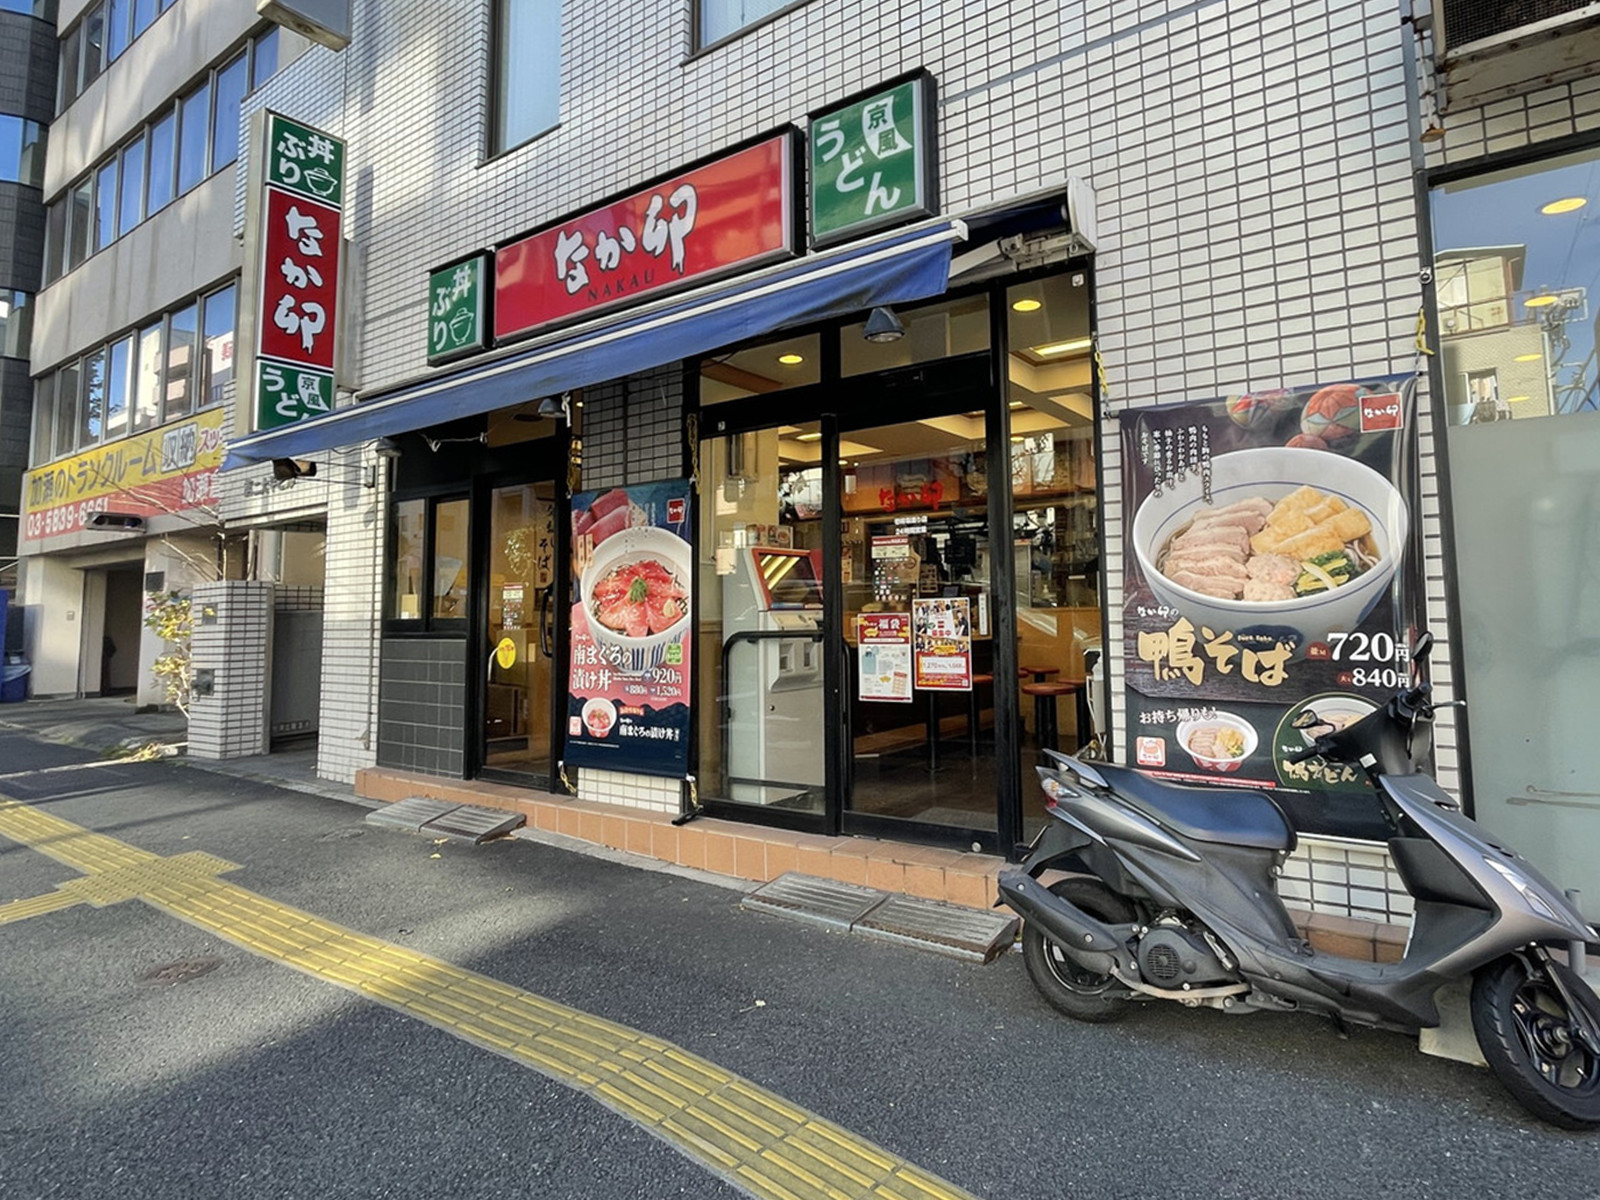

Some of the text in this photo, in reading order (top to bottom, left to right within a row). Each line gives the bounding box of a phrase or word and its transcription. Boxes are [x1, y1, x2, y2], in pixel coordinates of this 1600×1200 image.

[867, 103, 899, 156] 京風
[816, 119, 901, 215] うどん
[554, 183, 697, 295] なか卯
[273, 205, 325, 354] なか卯
[588, 269, 656, 302] NAKAU
[262, 367, 310, 421] うど
[301, 376, 321, 407] 京風
[1364, 404, 1399, 418] なか卯
[1137, 606, 1179, 618] なか卯の
[574, 643, 632, 666] 南まぐろの
[1138, 617, 1296, 686] 鴨そば
[1327, 632, 1410, 662] 720円
[572, 668, 612, 691] 漬け丼
[652, 668, 682, 684] 920円
[1352, 668, 1410, 688] 840円
